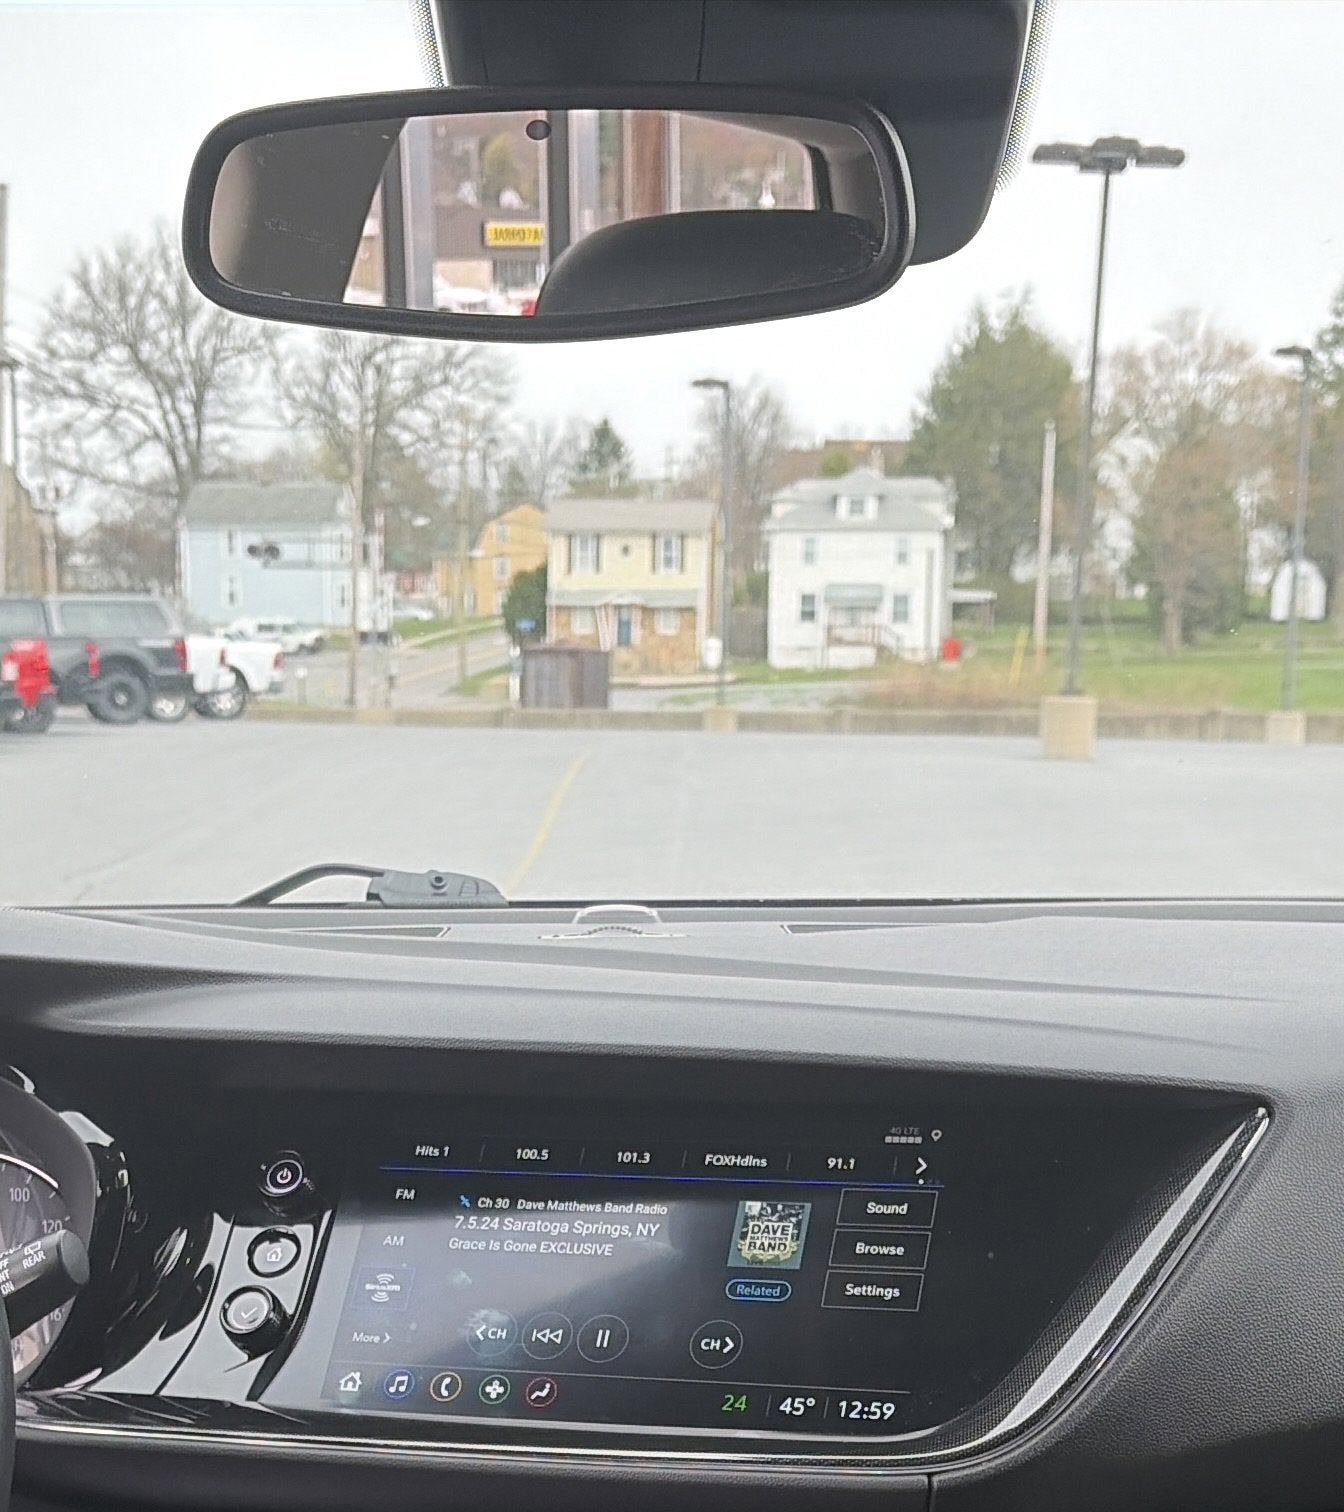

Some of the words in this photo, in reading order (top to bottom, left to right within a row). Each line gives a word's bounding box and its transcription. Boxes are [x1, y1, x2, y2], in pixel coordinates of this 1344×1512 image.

[415, 1145, 440, 1158] Hits
[443, 1146, 450, 1157] 1
[516, 1148, 549, 1161] 100.5
[616, 1152, 651, 1164] 101.3
[827, 1158, 856, 1170] 91.1
[8, 1188, 30, 1203] 100
[395, 1189, 415, 1200] FM
[478, 1198, 493, 1209] Ch
[495, 1198, 509, 1209] 30
[516, 1199, 544, 1211] Dave
[546, 1200, 602, 1213] Matthews
[604, 1202, 633, 1214] Band
[635, 1203, 668, 1216] Radio
[866, 1202, 908, 1216] Sound
[42, 1219, 63, 1234] 120
[454, 1216, 499, 1231] 7.5.24
[503, 1218, 569, 1235] Saratoga
[572, 1221, 633, 1238] Springs,
[636, 1223, 660, 1236] NY
[751, 1224, 790, 1235] DAVE
[382, 1235, 404, 1247] AM
[449, 1238, 486, 1251] Grace
[489, 1239, 500, 1251] Is
[503, 1240, 537, 1253] Gone
[539, 1242, 613, 1256] EXCLUSIVE
[748, 1242, 787, 1252] BAND
[855, 1243, 904, 1256] Browse
[23, 1251, 46, 1269] REAR
[736, 1284, 780, 1297] Related
[844, 1284, 900, 1299] Settings
[352, 1332, 380, 1343] More
[488, 1328, 507, 1340] CH
[700, 1338, 720, 1351] CH
[721, 1395, 748, 1411] 24
[779, 1397, 816, 1415] 45°
[838, 1400, 895, 1420] 12:59
